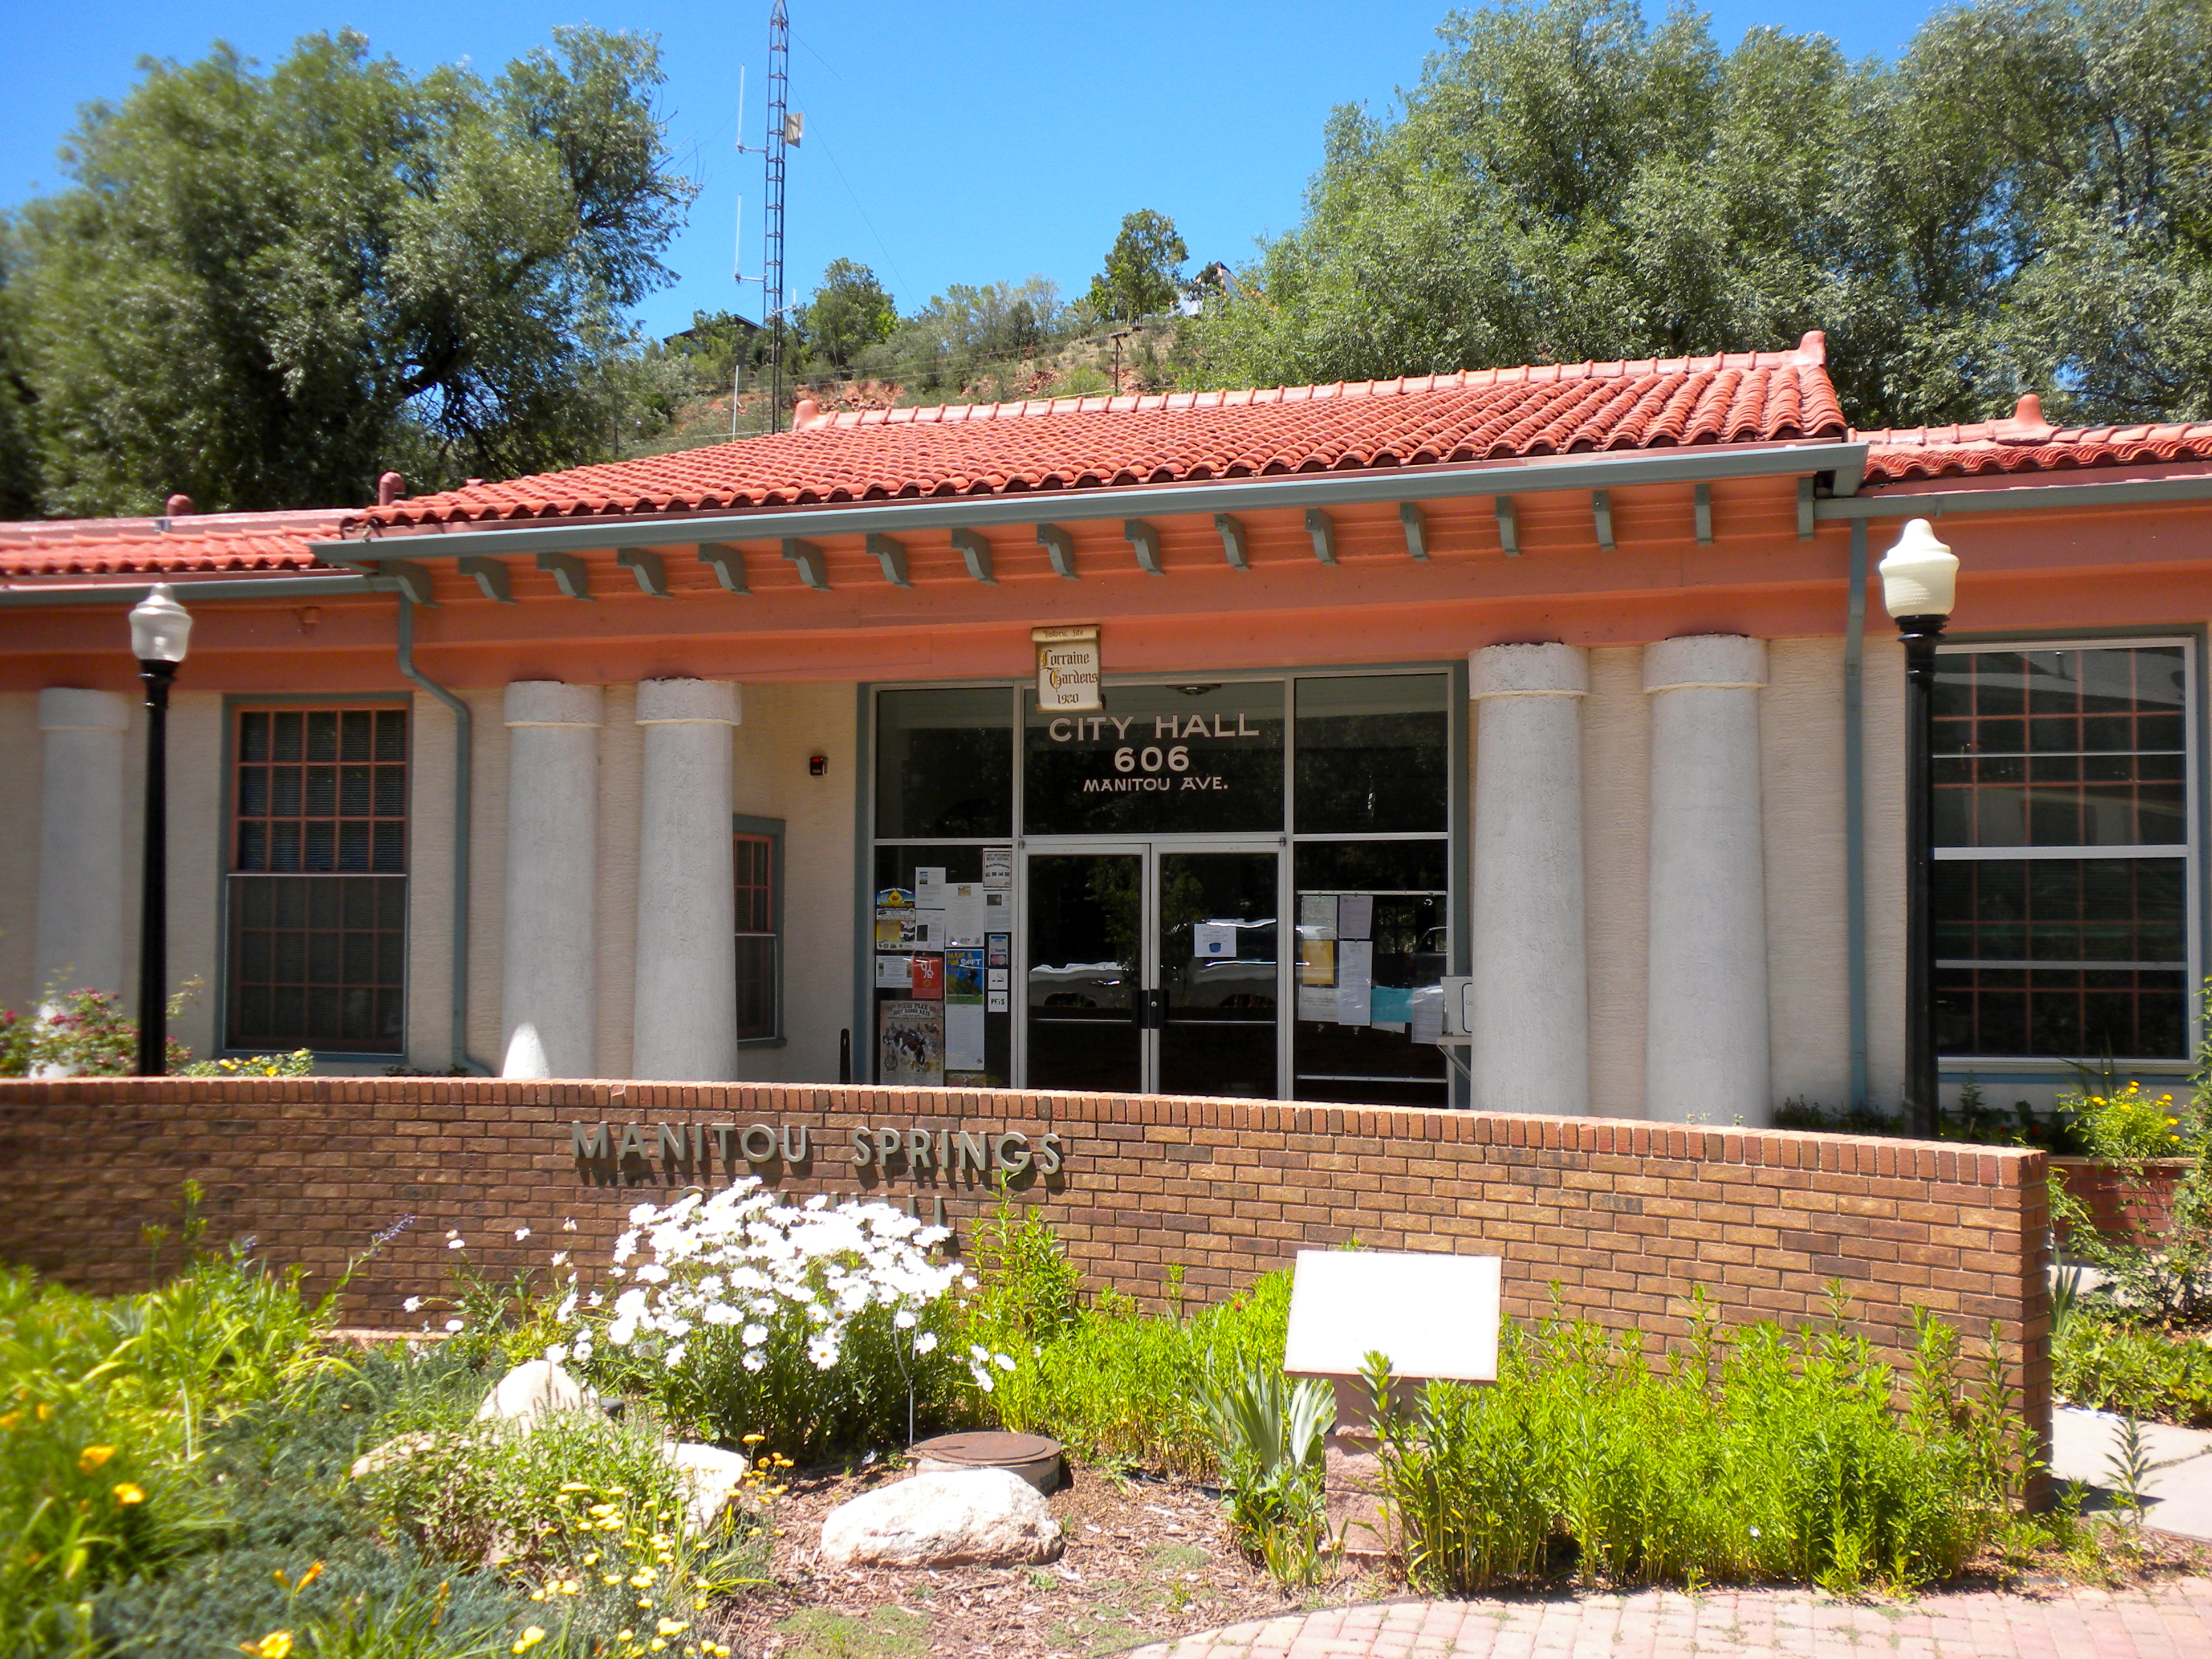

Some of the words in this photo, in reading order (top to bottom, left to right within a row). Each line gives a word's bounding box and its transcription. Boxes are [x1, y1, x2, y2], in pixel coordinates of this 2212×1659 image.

[1038, 649, 1089, 667] Lorraine
[1042, 667, 1098, 693] Gardens
[1057, 693, 1079, 705] 1920
[1048, 715, 1134, 742] CITY
[1154, 713, 1259, 739] HALL
[1113, 746, 1190, 772] 606
[1083, 778, 1170, 792] MANITOU
[1180, 776, 1229, 791] AVE.
[571, 1120, 807, 1163] MANITOU
[851, 1126, 1061, 1175] SPRINGS
